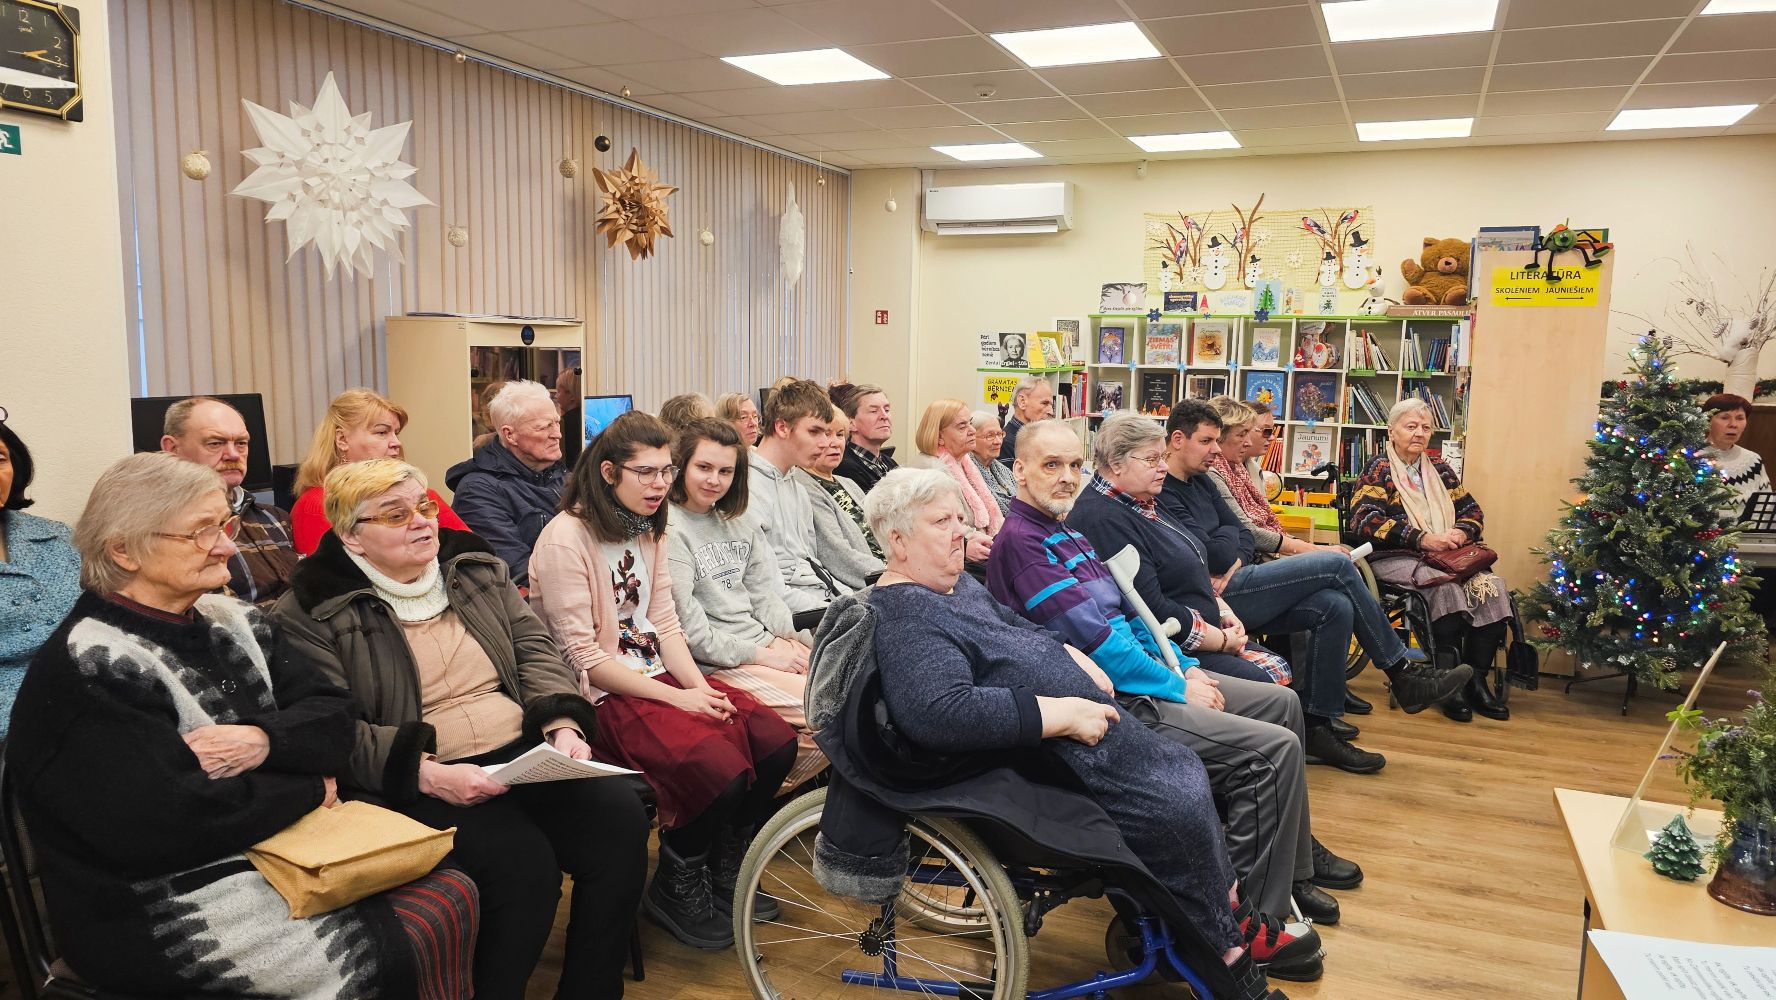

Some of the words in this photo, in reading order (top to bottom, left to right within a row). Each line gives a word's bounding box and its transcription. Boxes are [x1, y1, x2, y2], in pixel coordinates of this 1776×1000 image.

[53, 36, 63, 50] 2
[23, 87, 32, 99] 6
[44, 90, 53, 103] 5
[721, 578, 732, 591] 78
